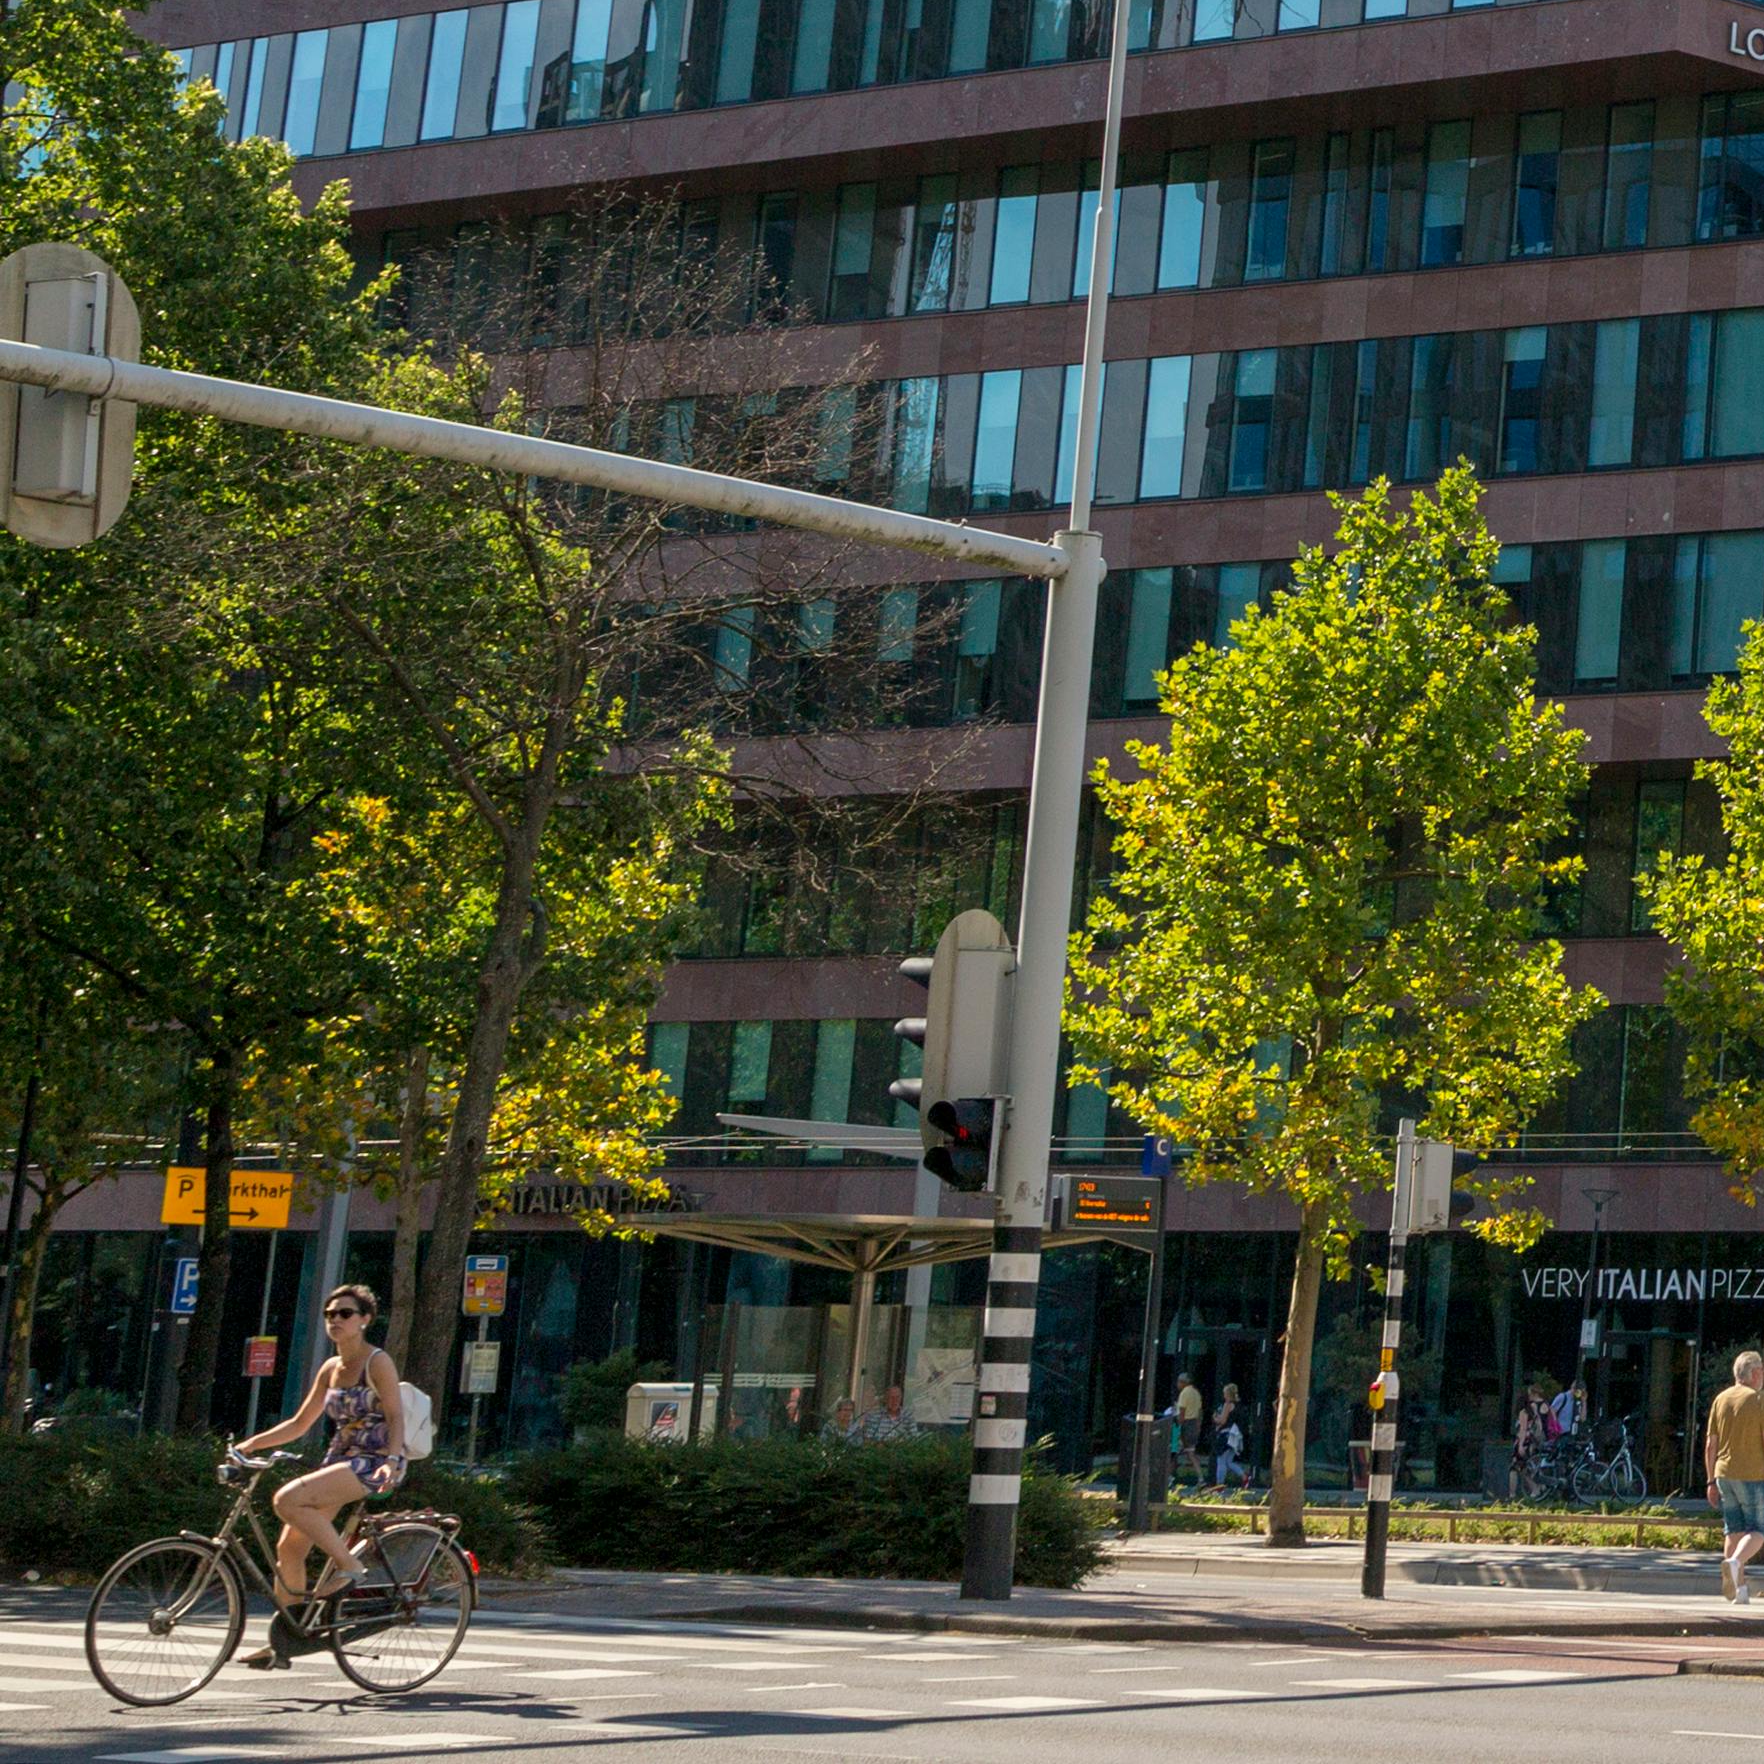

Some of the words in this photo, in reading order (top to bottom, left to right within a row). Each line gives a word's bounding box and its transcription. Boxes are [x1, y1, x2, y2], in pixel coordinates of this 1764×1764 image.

[1156, 1138, 1168, 1156] C
[178, 1179, 194, 1199] P
[229, 1183, 291, 1199] rkthal
[1522, 1268, 1590, 1299] VERY
[1597, 1268, 1706, 1301] ITALIAN
